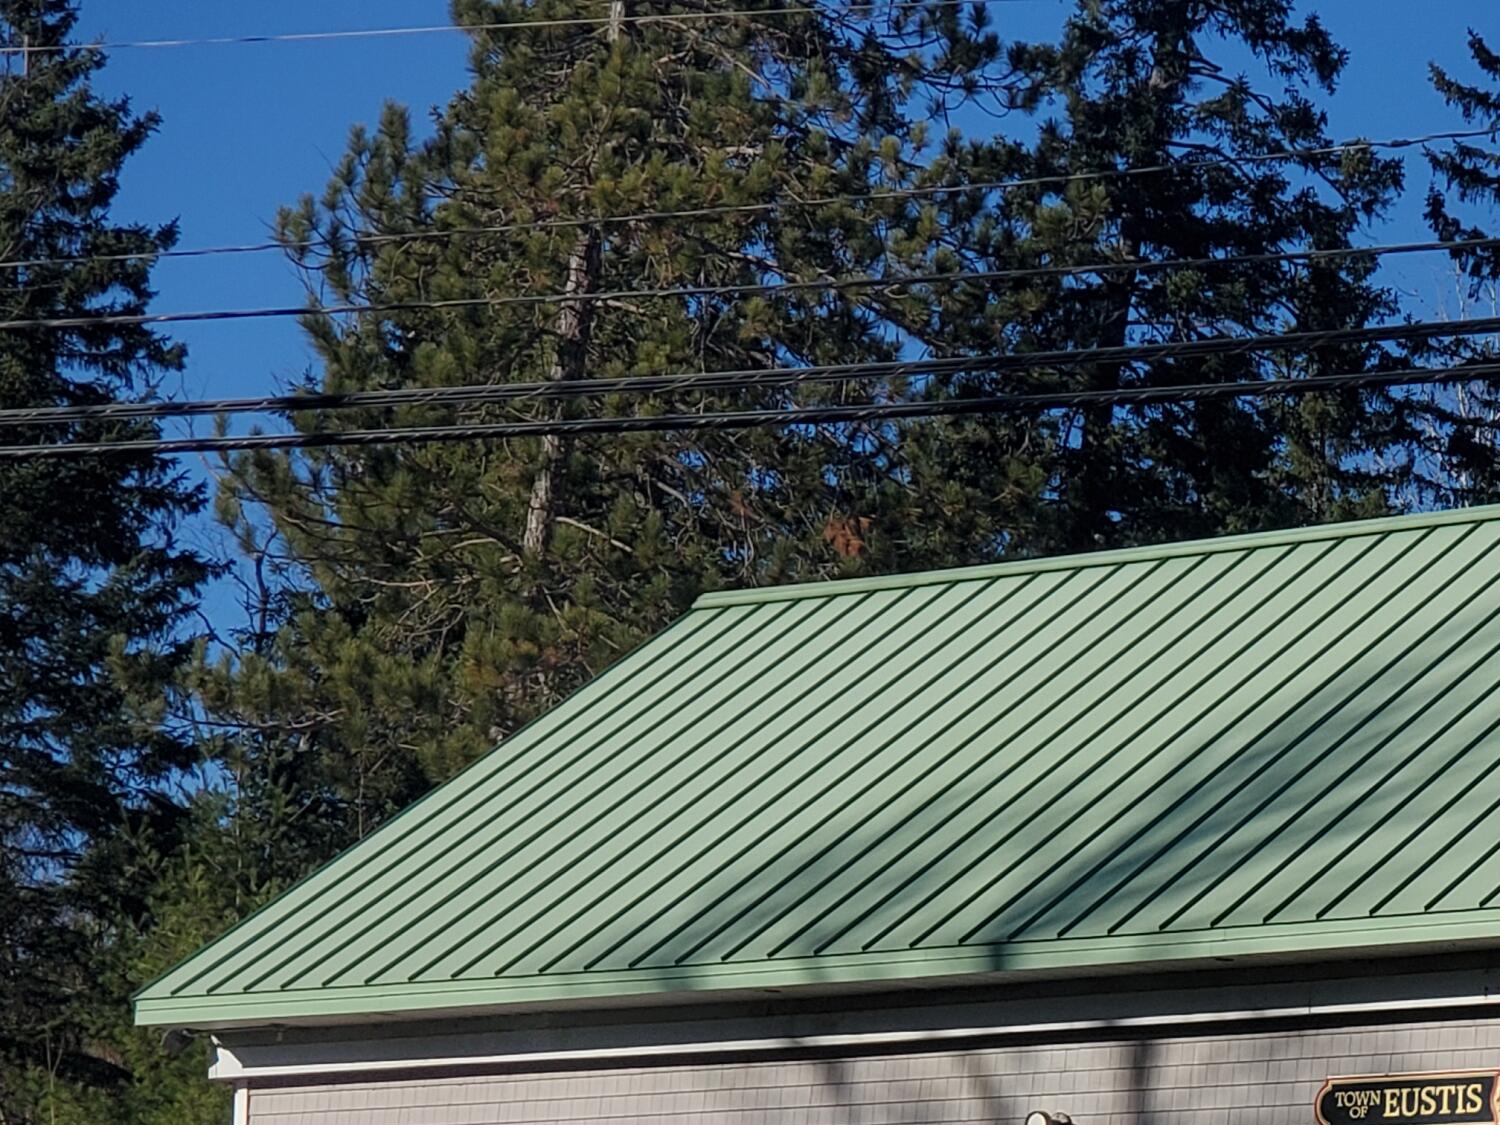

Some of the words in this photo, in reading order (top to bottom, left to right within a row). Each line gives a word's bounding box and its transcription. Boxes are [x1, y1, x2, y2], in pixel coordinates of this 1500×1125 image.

[1335, 1090, 1382, 1107] TOWN
[1383, 1084, 1482, 1118] EUSTIS
[1350, 1106, 1369, 1119] OF
